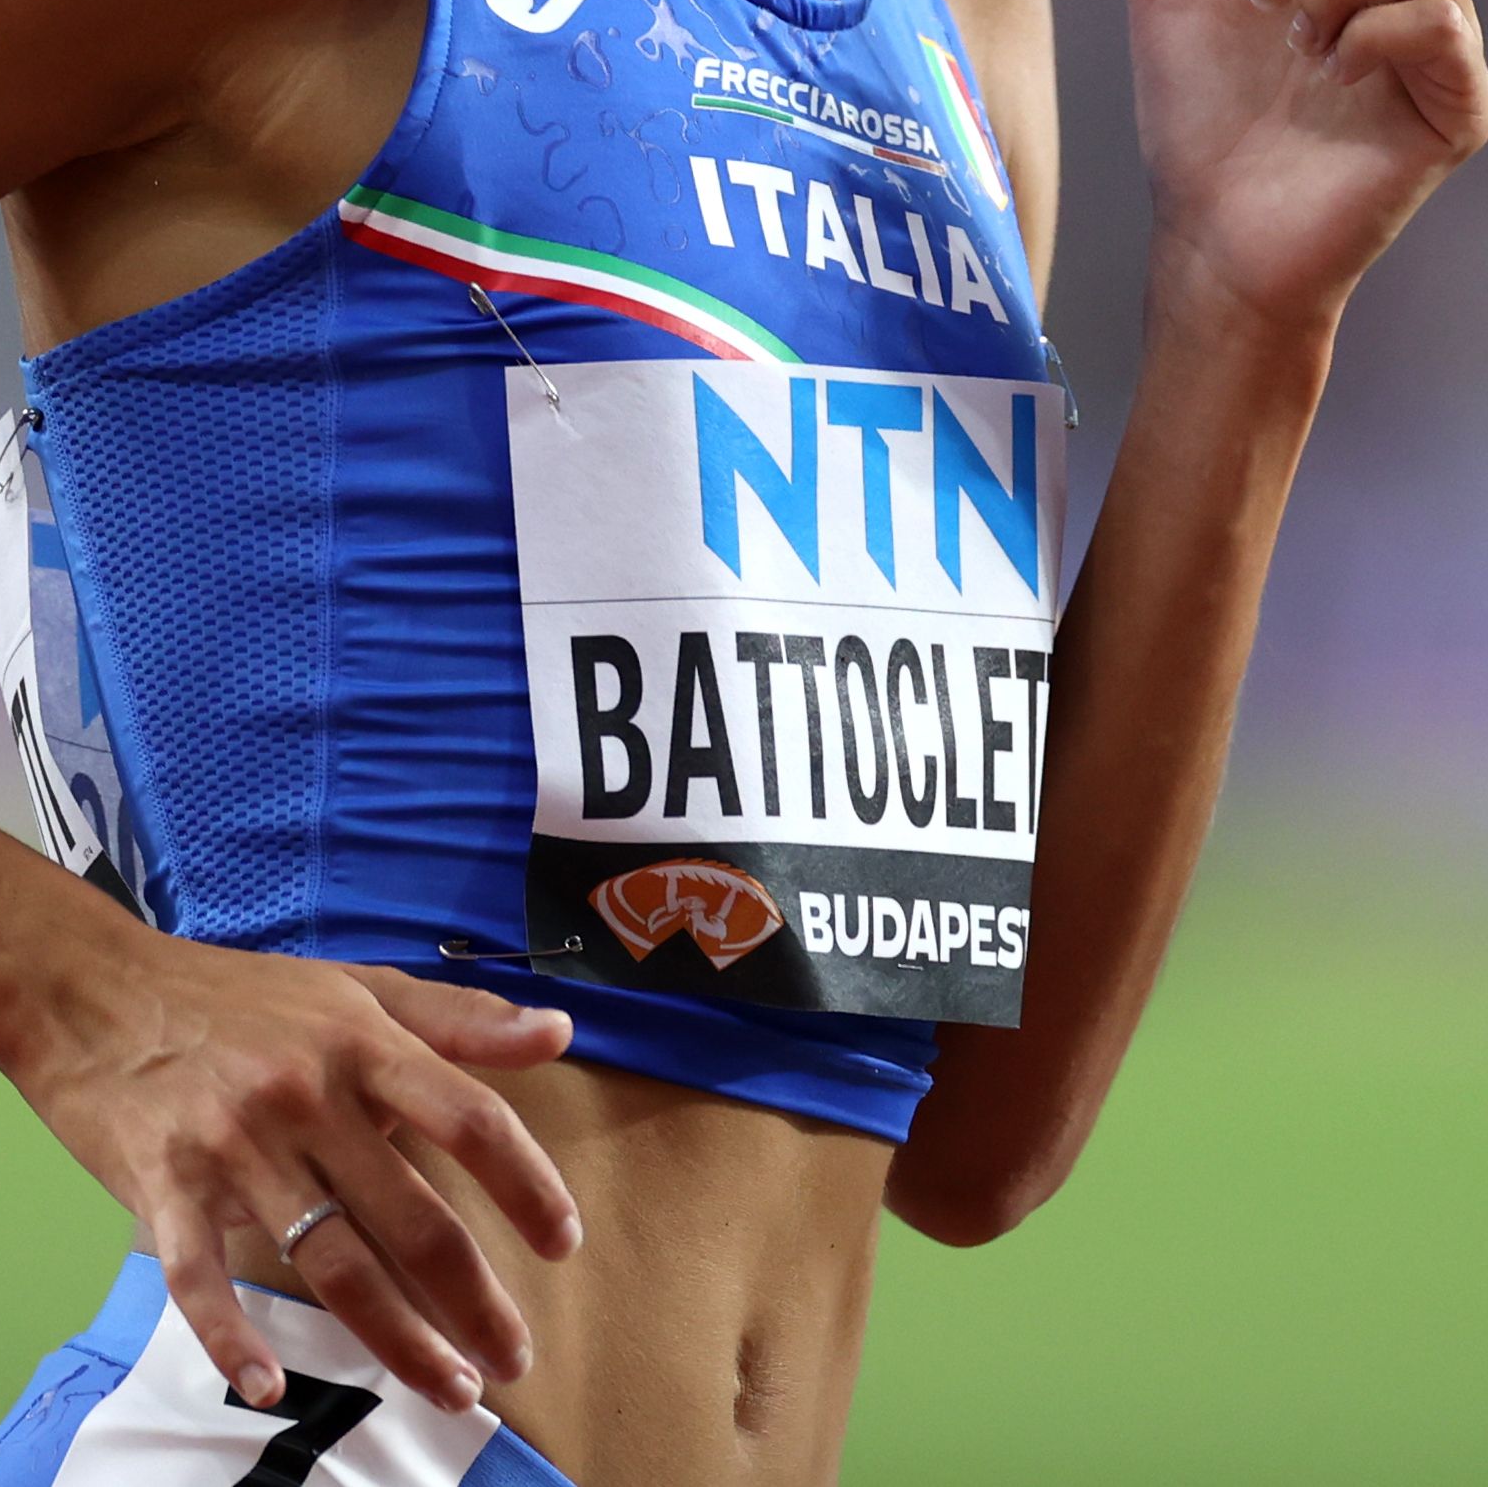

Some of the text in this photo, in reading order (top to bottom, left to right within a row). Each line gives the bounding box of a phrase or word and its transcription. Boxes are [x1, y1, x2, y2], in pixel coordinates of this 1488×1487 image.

[693, 57, 941, 159] FRECCIAROSSA
[688, 156, 1009, 325] ITALIA
[691, 370, 1040, 603] NTN
[570, 630, 1052, 835] BATTOCLET
